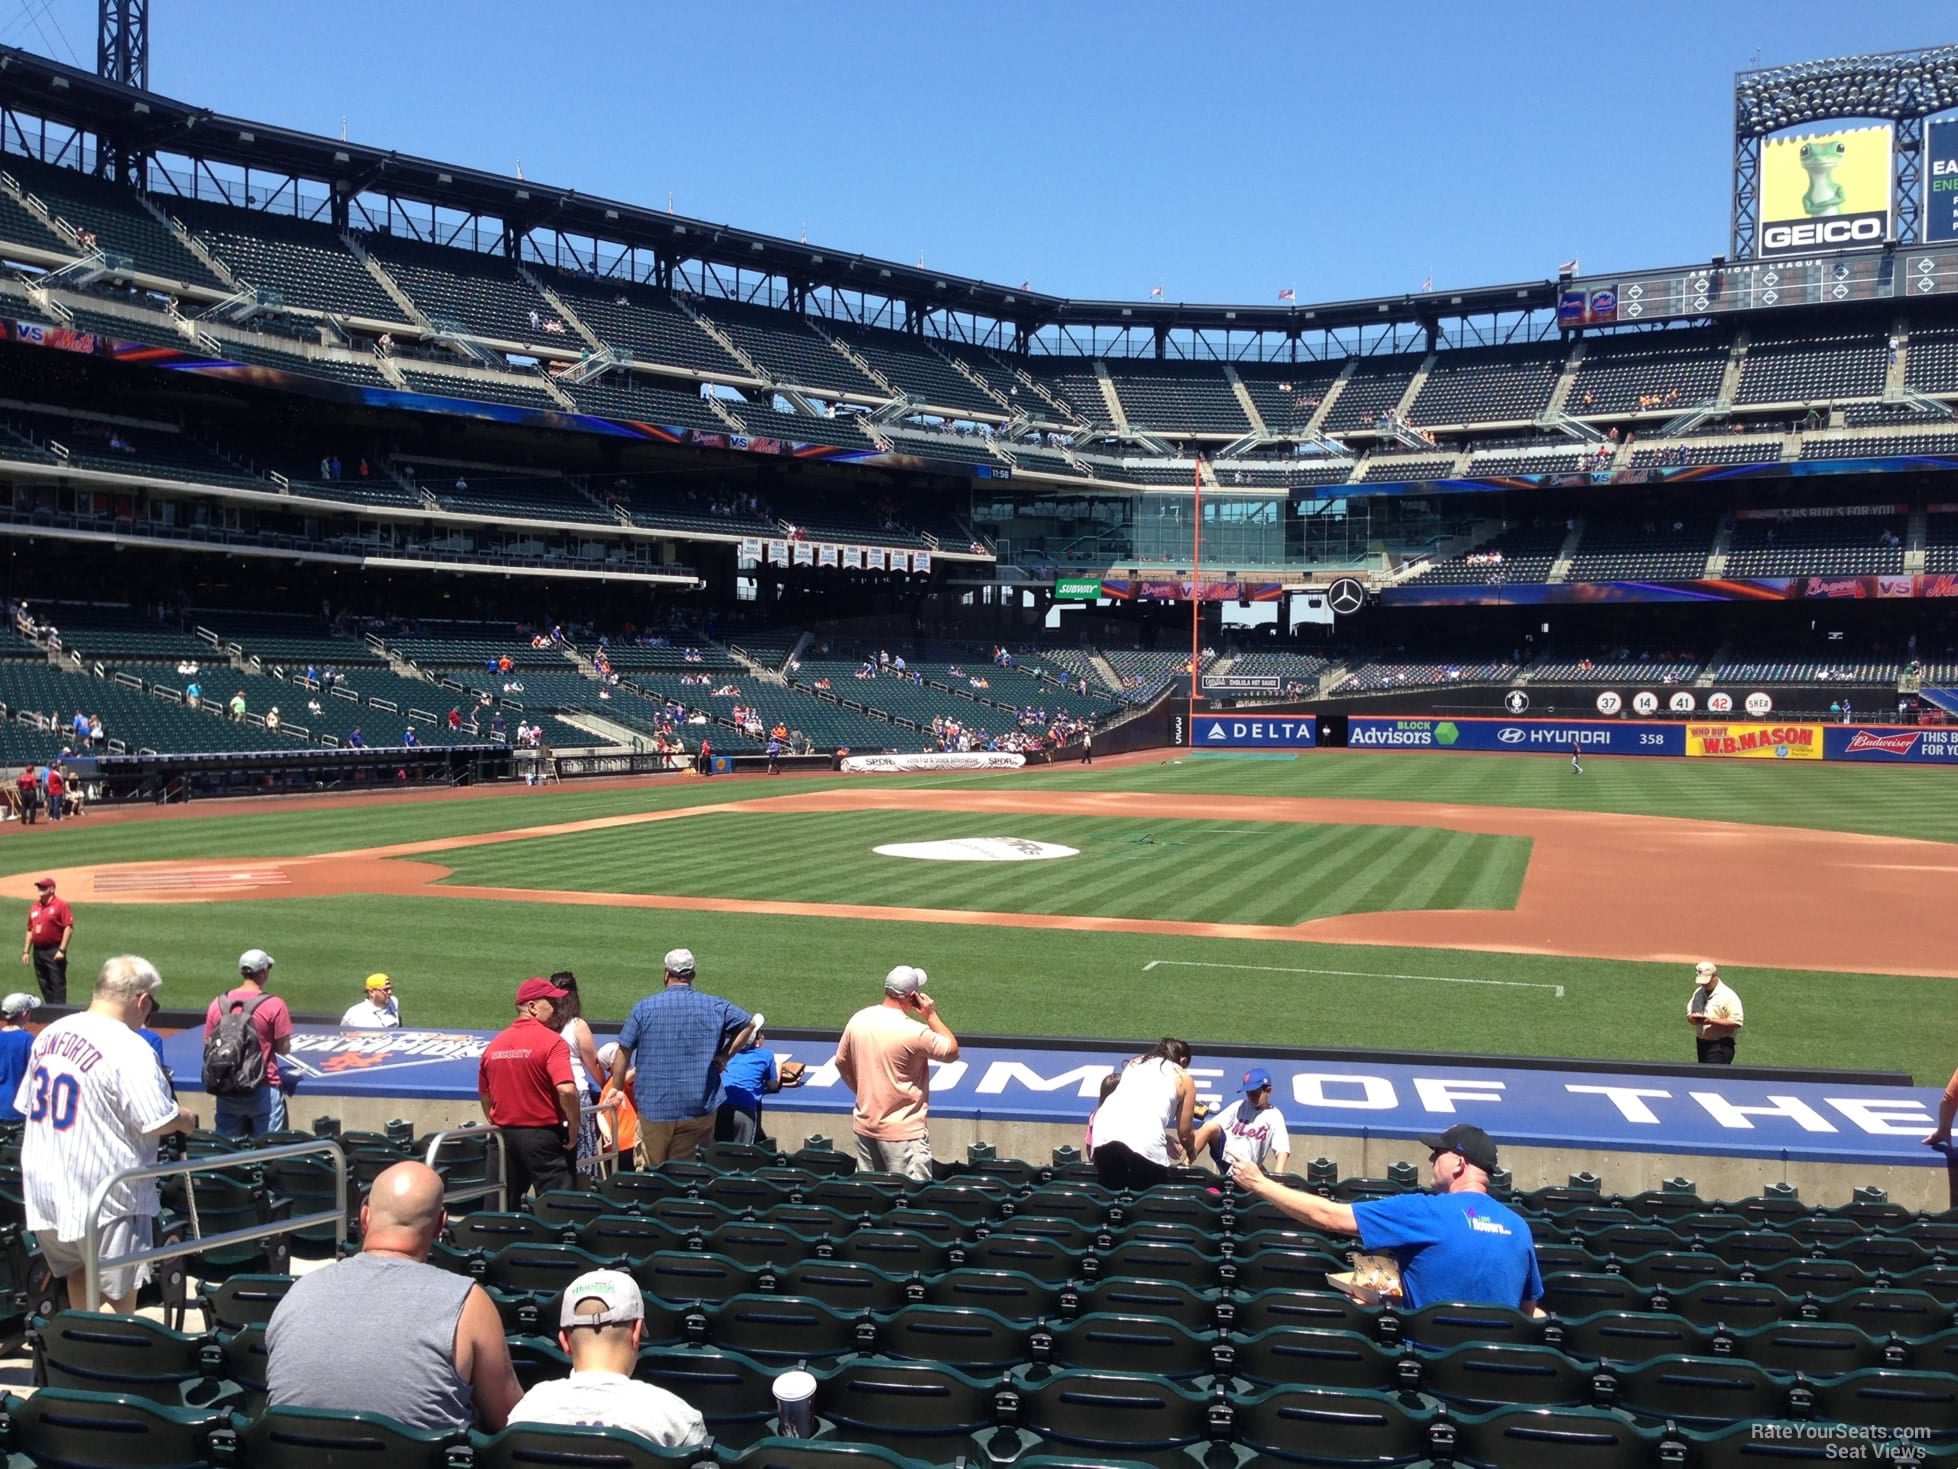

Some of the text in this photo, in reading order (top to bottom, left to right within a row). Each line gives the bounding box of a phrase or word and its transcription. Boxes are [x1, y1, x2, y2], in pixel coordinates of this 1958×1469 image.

[1764, 218, 1880, 248] GEICO
[1769, 260, 1823, 270] LEAGUE
[17, 324, 43, 341] VS
[731, 437, 747, 448] VS
[1592, 474, 1610, 482] VS
[1060, 585, 1097, 593] SUBWAY
[1879, 581, 1910, 594] VS
[1601, 698, 1616, 708] 37
[1640, 698, 1651, 708] 14
[1676, 698, 1689, 708] 41
[1711, 698, 1728, 709] 42
[1233, 723, 1310, 738] DELTA
[1397, 721, 1430, 731] BLOCK
[1350, 728, 1431, 744] Advisors
[1530, 730, 1610, 744] HYUNDAI
[1639, 734, 1664, 745] 358
[1852, 735, 1912, 748] Budweiser
[1922, 732, 1947, 744] THIS
[1921, 744, 1944, 755] FOR
[30, 1065, 80, 1132] 30
[1292, 1072, 1507, 1114] OF
[1564, 1082, 1958, 1137] THE
